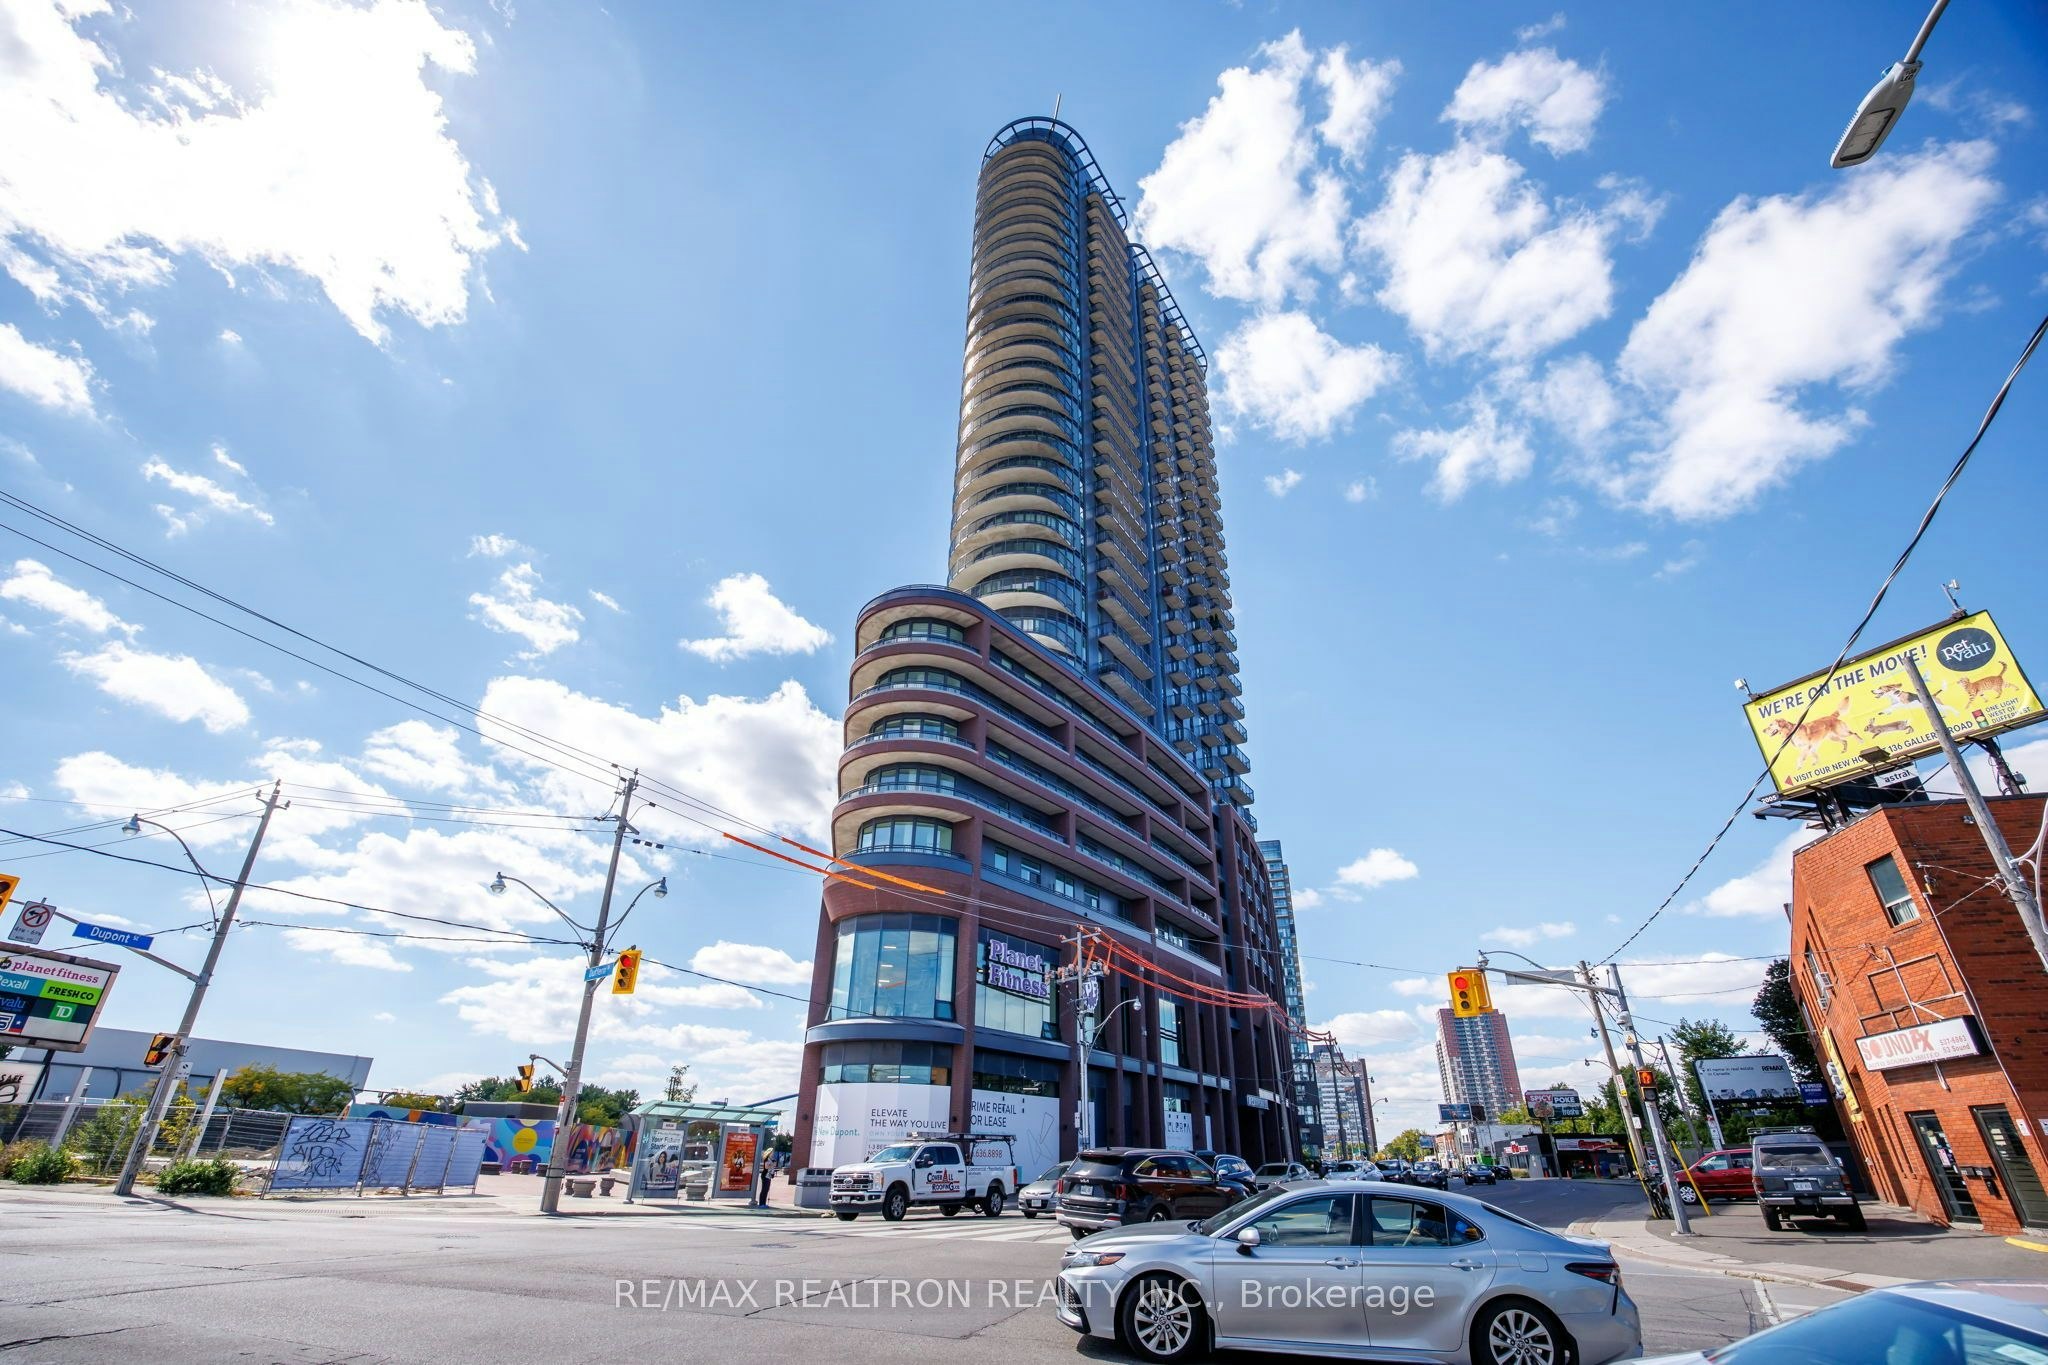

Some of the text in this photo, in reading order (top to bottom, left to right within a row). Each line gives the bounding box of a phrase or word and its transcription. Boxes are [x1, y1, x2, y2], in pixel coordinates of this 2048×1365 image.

[1942, 639, 1973, 662] pet
[1953, 641, 1991, 662] valu
[1758, 643, 1928, 719] WE'RE ON THE MOVE!
[1985, 697, 2019, 713] ONE LIGHT
[1988, 705, 2016, 718] WEST OF
[1793, 771, 1813, 783] VISIT
[1814, 766, 1831, 777] OUR
[1832, 759, 1850, 771] NEW
[1888, 743, 1903, 753] 136
[1904, 732, 1939, 750] GALLER
[1949, 720, 1973, 734] ROAD
[1884, 769, 1911, 783] astral
[1761, 794, 1777, 804] 2005
[90, 926, 131, 944] Dupont
[989, 939, 1043, 973] Planet
[988, 961, 1050, 998] Fitness
[55, 1004, 73, 1018] TD
[971, 1100, 1017, 1115] RIME RETAIL
[1554, 1096, 1576, 1104] POKE
[871, 1108, 908, 1118] ELEVATE
[871, 1118, 947, 1130] THE WAY YOU LIVE
[971, 1114, 1007, 1128] OR LEASE
